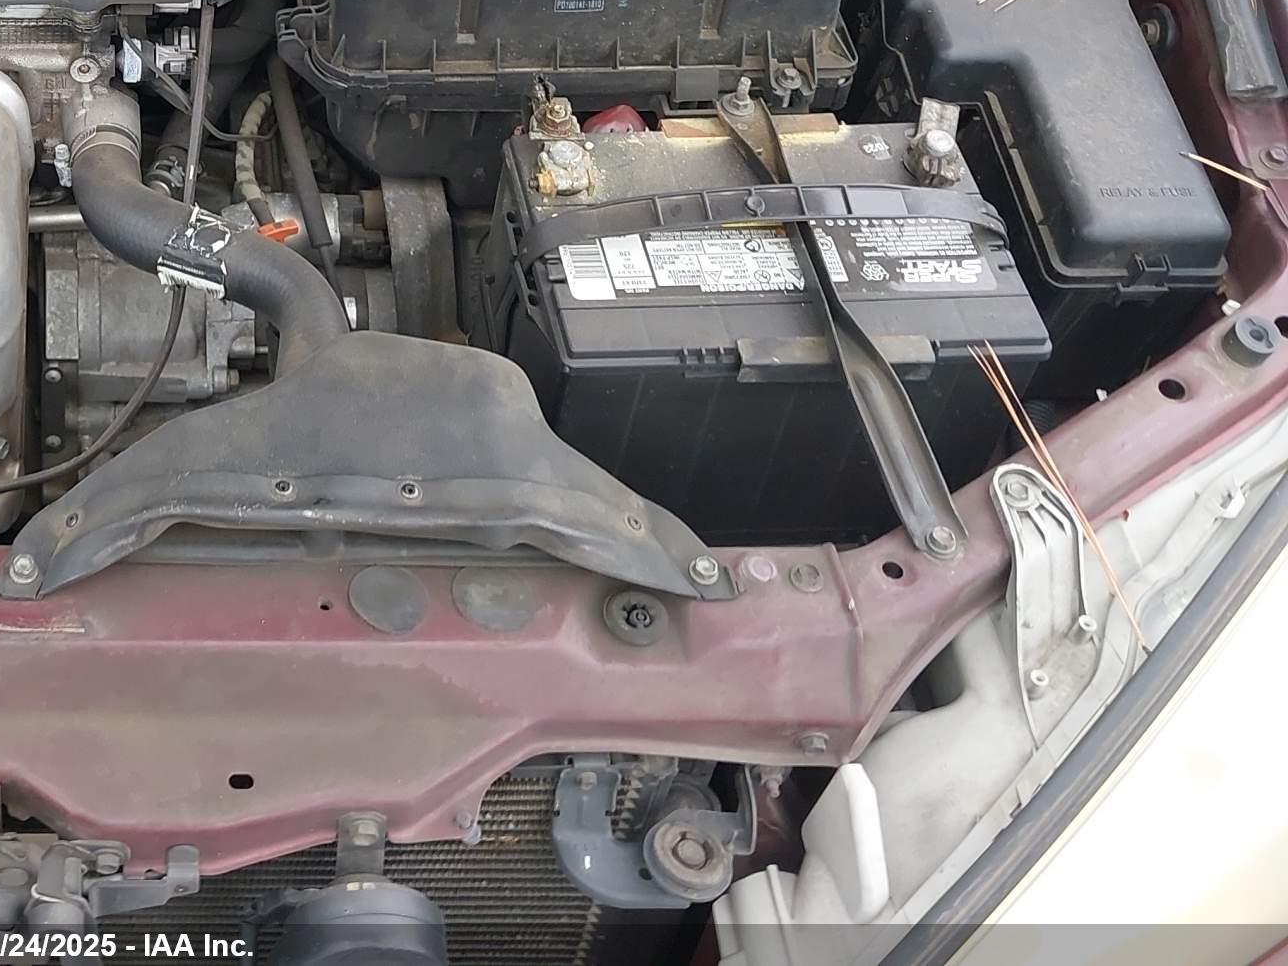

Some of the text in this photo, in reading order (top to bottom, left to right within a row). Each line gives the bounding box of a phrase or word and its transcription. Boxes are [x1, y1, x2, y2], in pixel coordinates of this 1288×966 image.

[1099, 186, 1199, 198] RELAY & FUSE
[900, 258, 982, 274] START
[903, 270, 978, 284] SUPER
